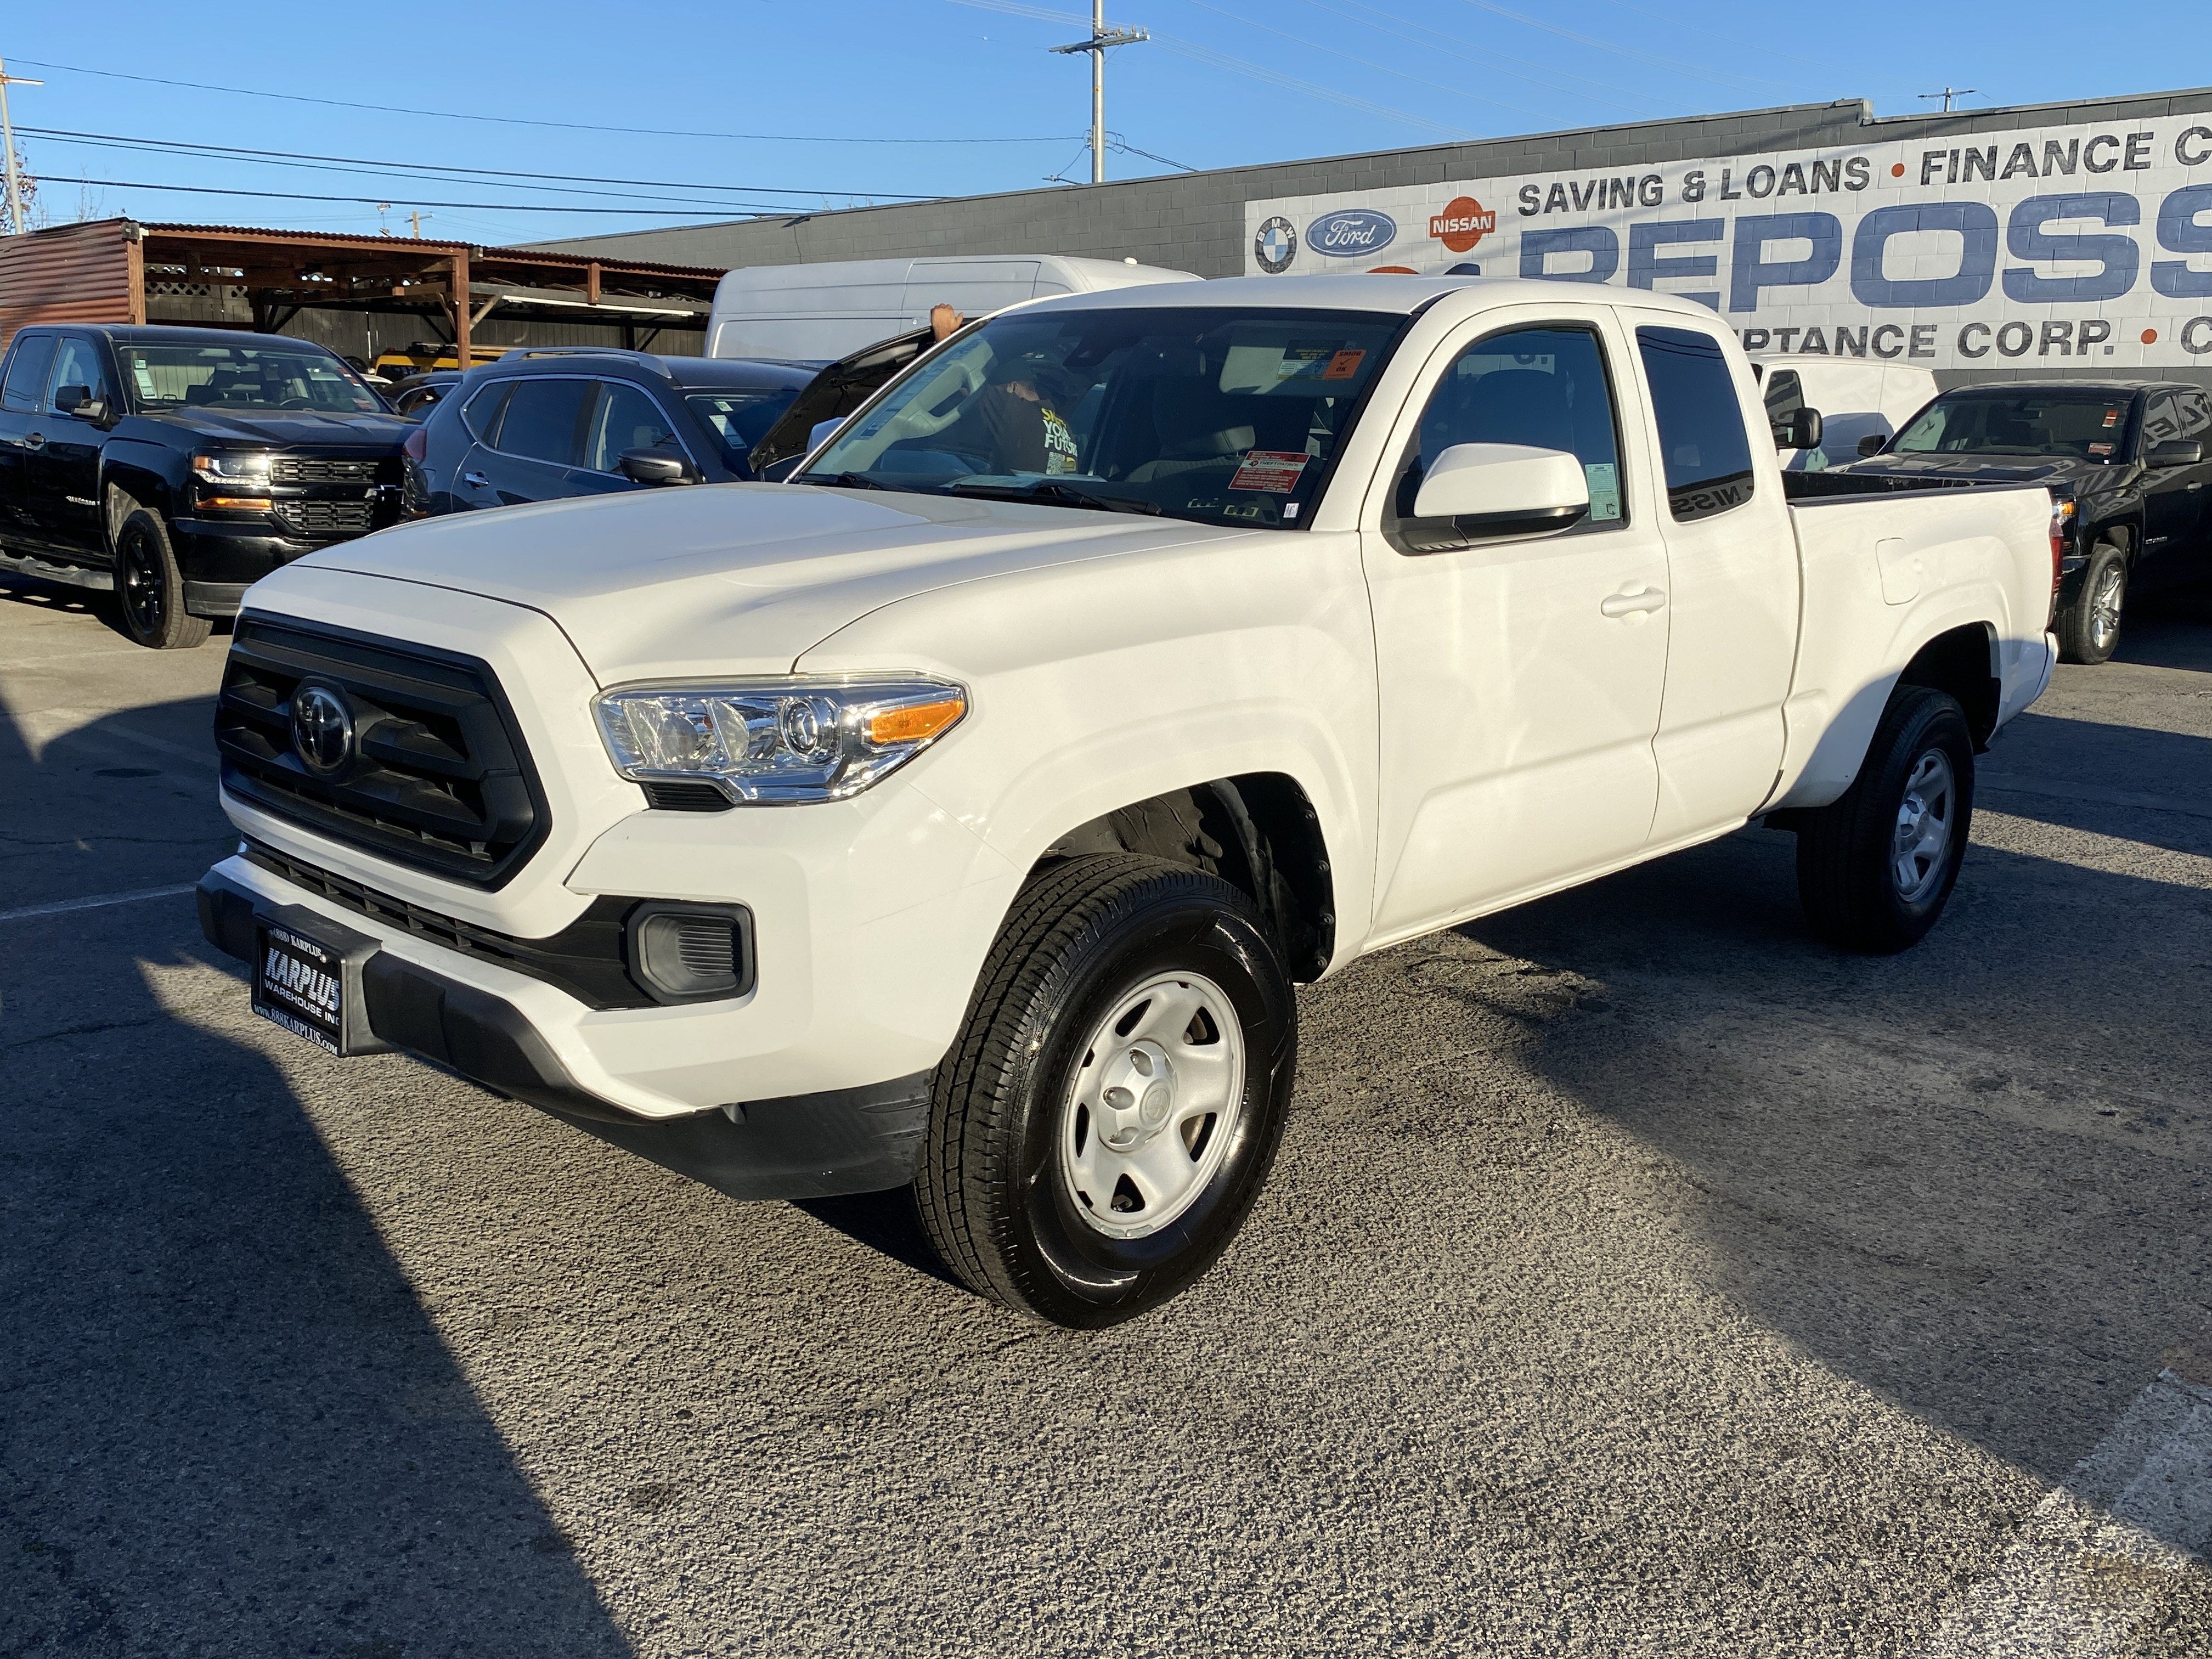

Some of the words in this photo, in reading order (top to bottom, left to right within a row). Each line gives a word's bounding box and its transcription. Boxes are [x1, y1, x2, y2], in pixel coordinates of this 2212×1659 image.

[1921, 132, 2154, 185] FINANCE
[1518, 175, 1663, 217] SAVING
[1681, 171, 1706, 202] &
[1720, 157, 1870, 201] LOANS
[1324, 219, 1376, 246] Ford
[1432, 216, 1492, 233] NISSAN
[1732, 325, 1938, 358] PTANCE
[1957, 319, 2115, 358] CORP.
[273, 928, 290, 943] (888)
[290, 935, 322, 957] KARPLUS
[264, 979, 322, 1018] WAREHOUSE
[266, 947, 340, 1011] KARPLUS
